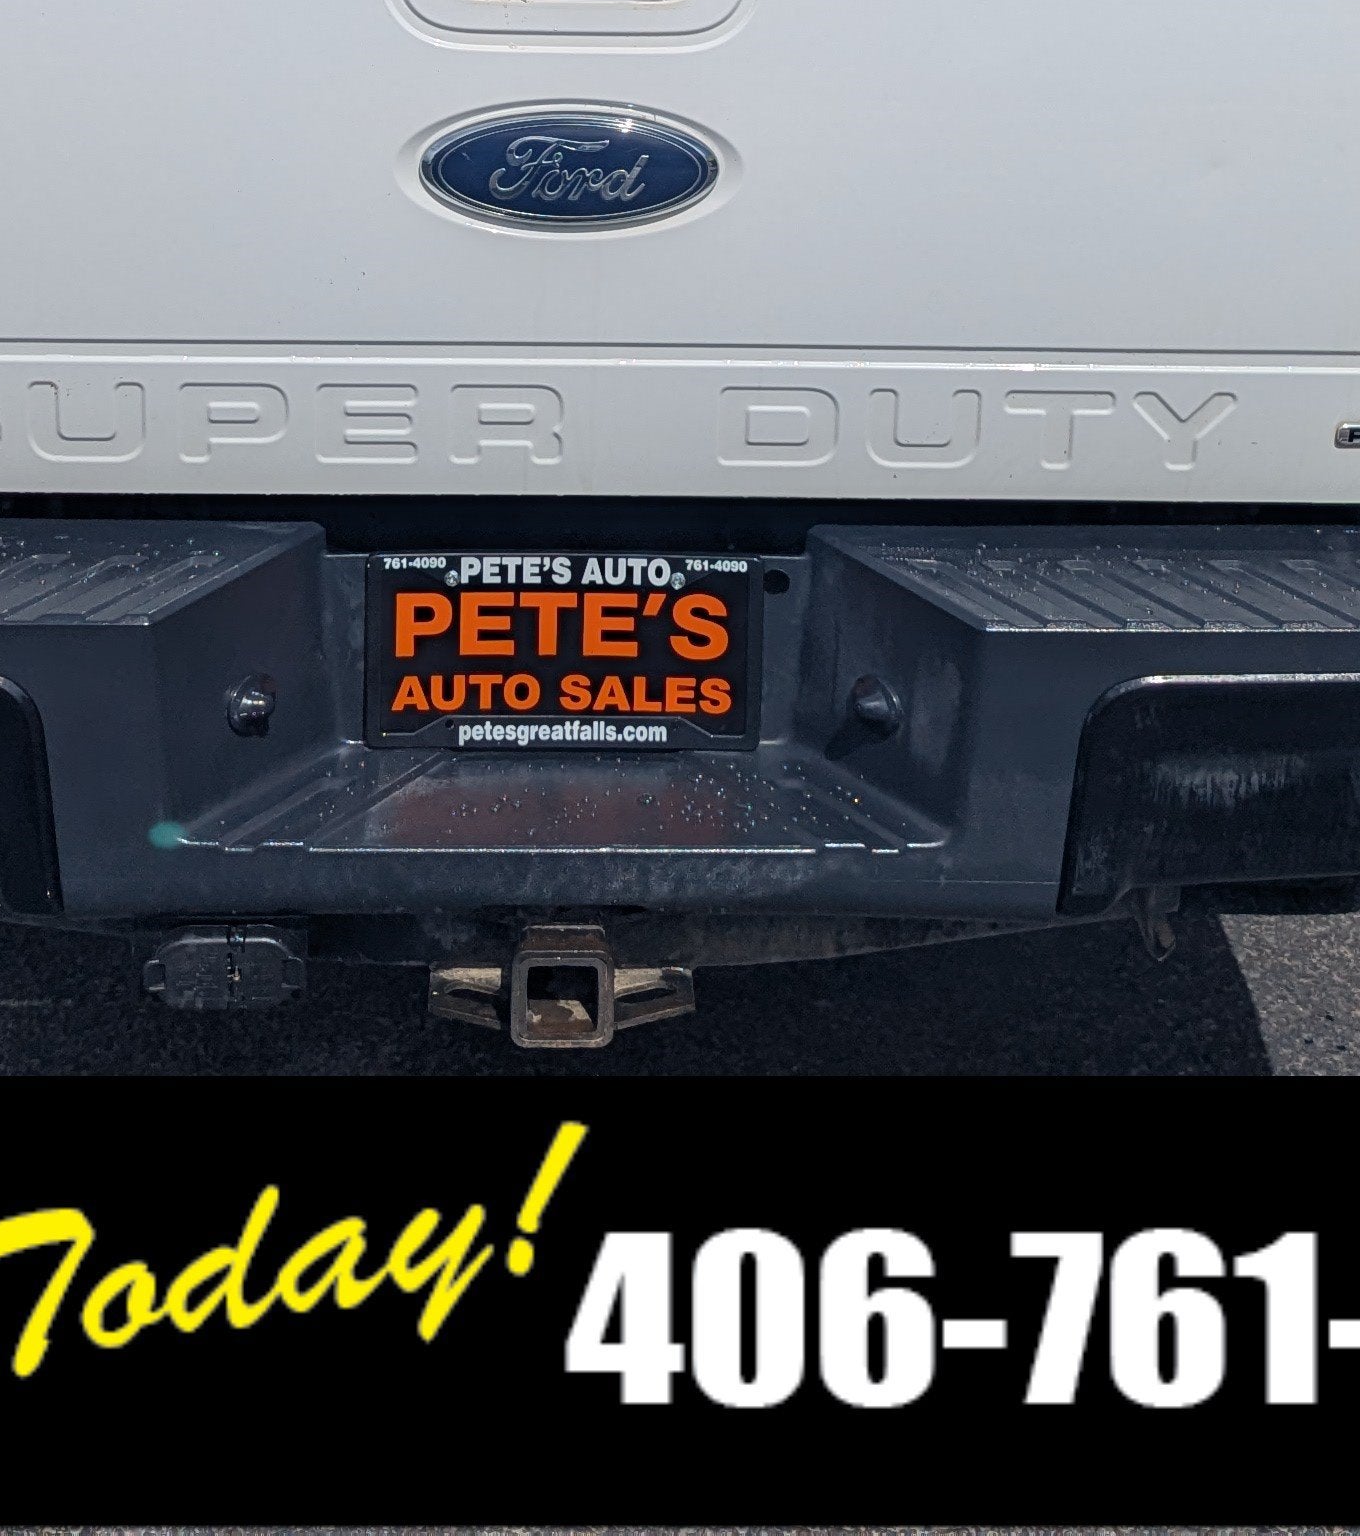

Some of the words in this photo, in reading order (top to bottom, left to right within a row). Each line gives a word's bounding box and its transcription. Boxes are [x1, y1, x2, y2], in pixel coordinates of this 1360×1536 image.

[489, 135, 649, 202] Ford
[716, 385, 1239, 470] DUTY
[383, 556, 446, 570] 761-4090
[460, 555, 572, 584] PETE'S
[581, 557, 671, 586] AUTO
[685, 558, 748, 573] 761-4090
[395, 591, 729, 661] PETE'S
[391, 673, 540, 712] AUTO
[559, 674, 732, 715] SALES
[458, 719, 667, 746] petesgreatfalls.com
